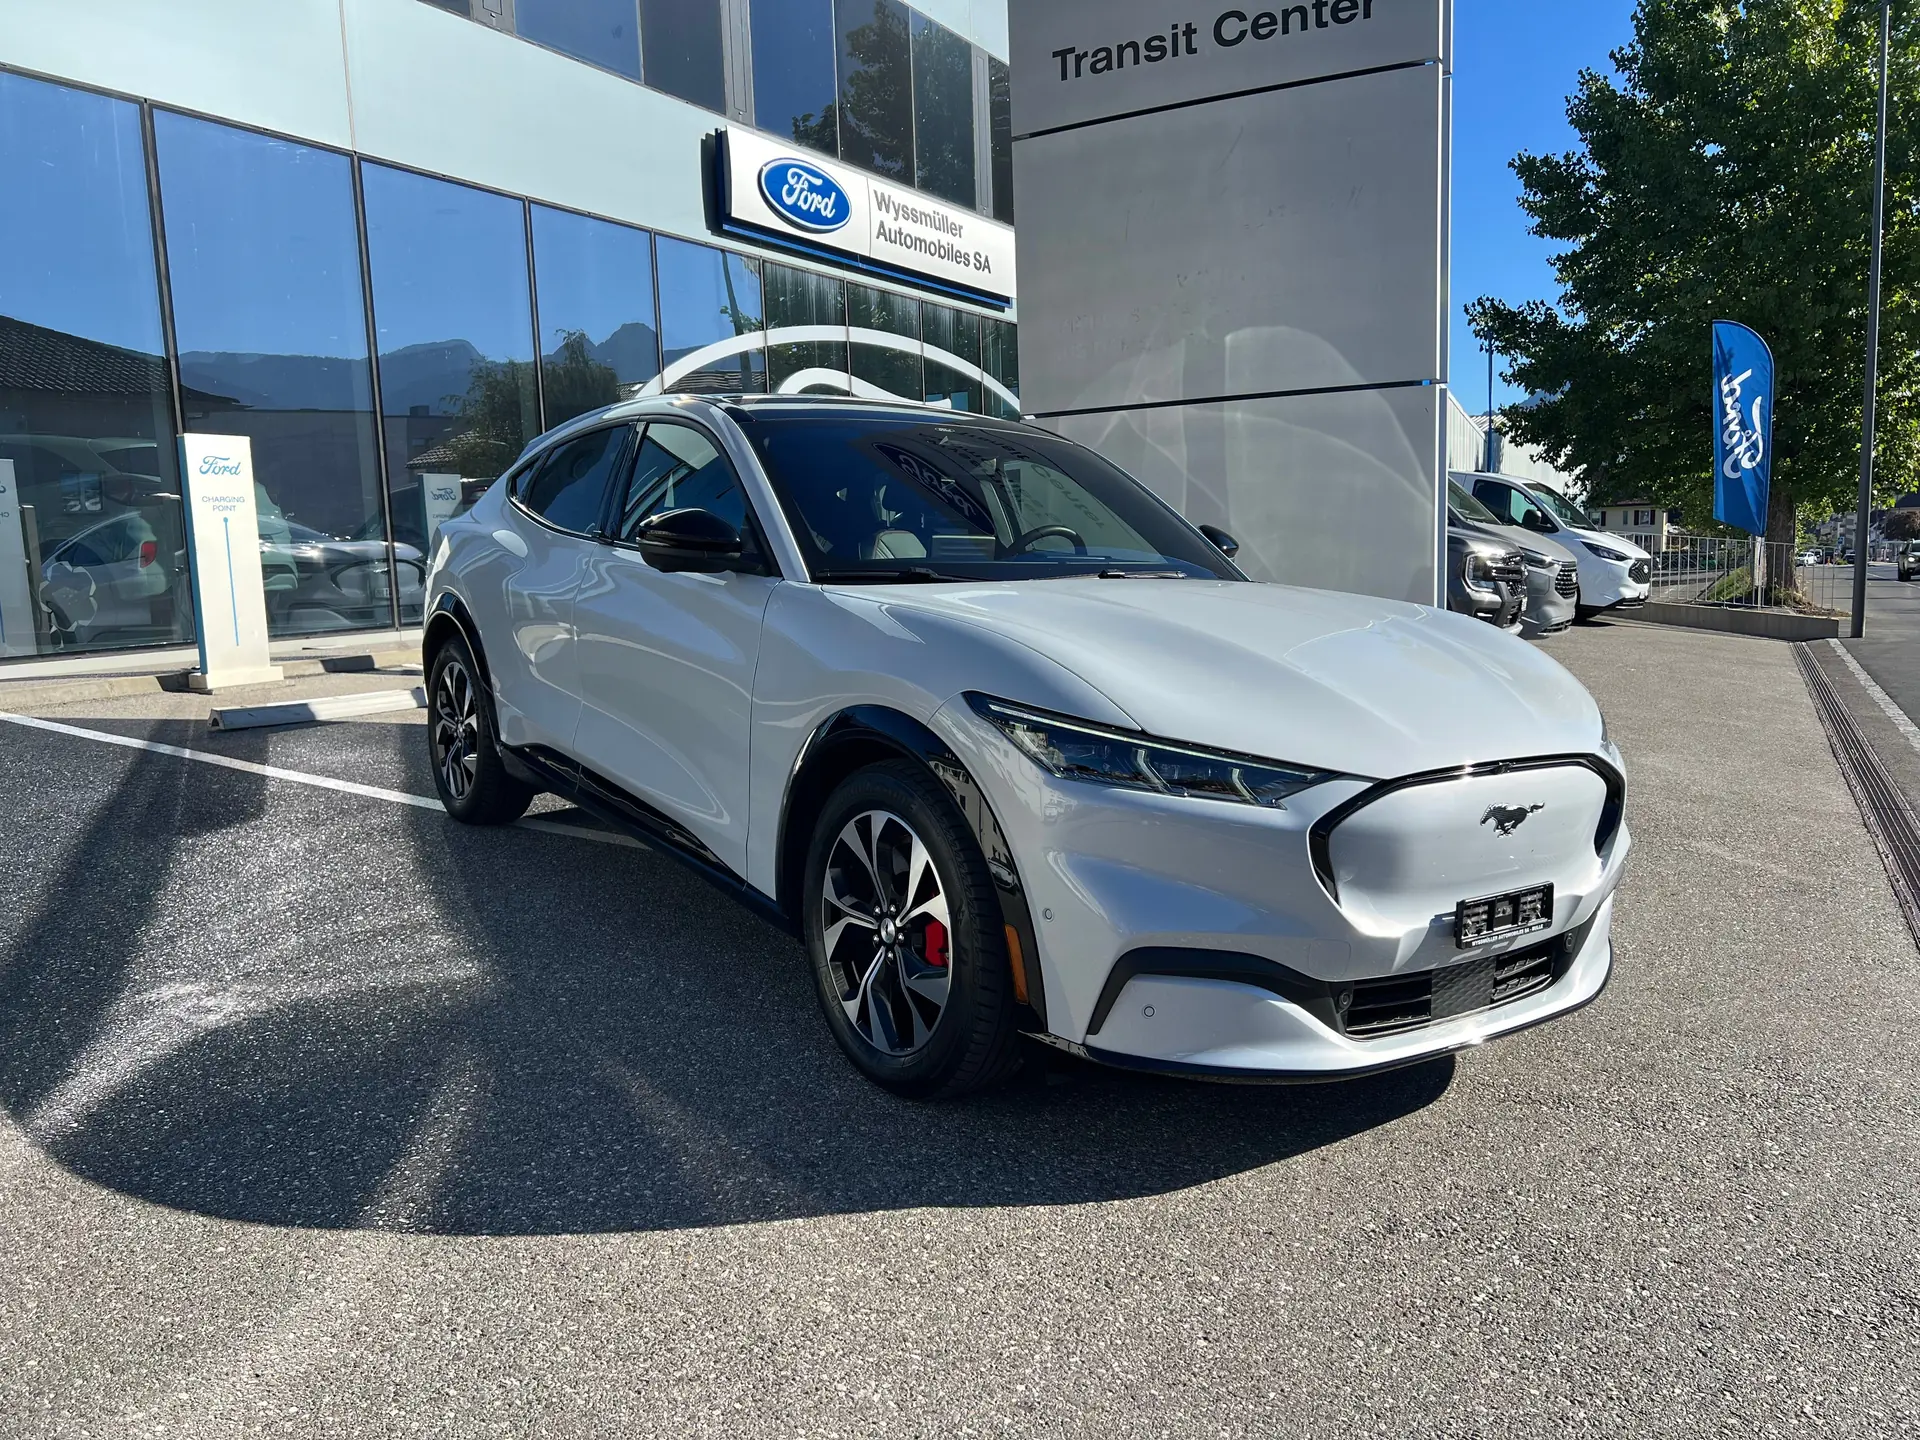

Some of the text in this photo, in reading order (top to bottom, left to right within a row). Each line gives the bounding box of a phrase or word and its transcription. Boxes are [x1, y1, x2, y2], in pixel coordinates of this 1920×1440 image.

[1052, 22, 1198, 82] Transit
[782, 167, 836, 219] Ford
[873, 189, 964, 239] Wyssmüller
[876, 220, 992, 274] Automobiles SA
[199, 455, 241, 476] Ford
[201, 495, 246, 503] CHARGING
[212, 504, 237, 512] POINT
